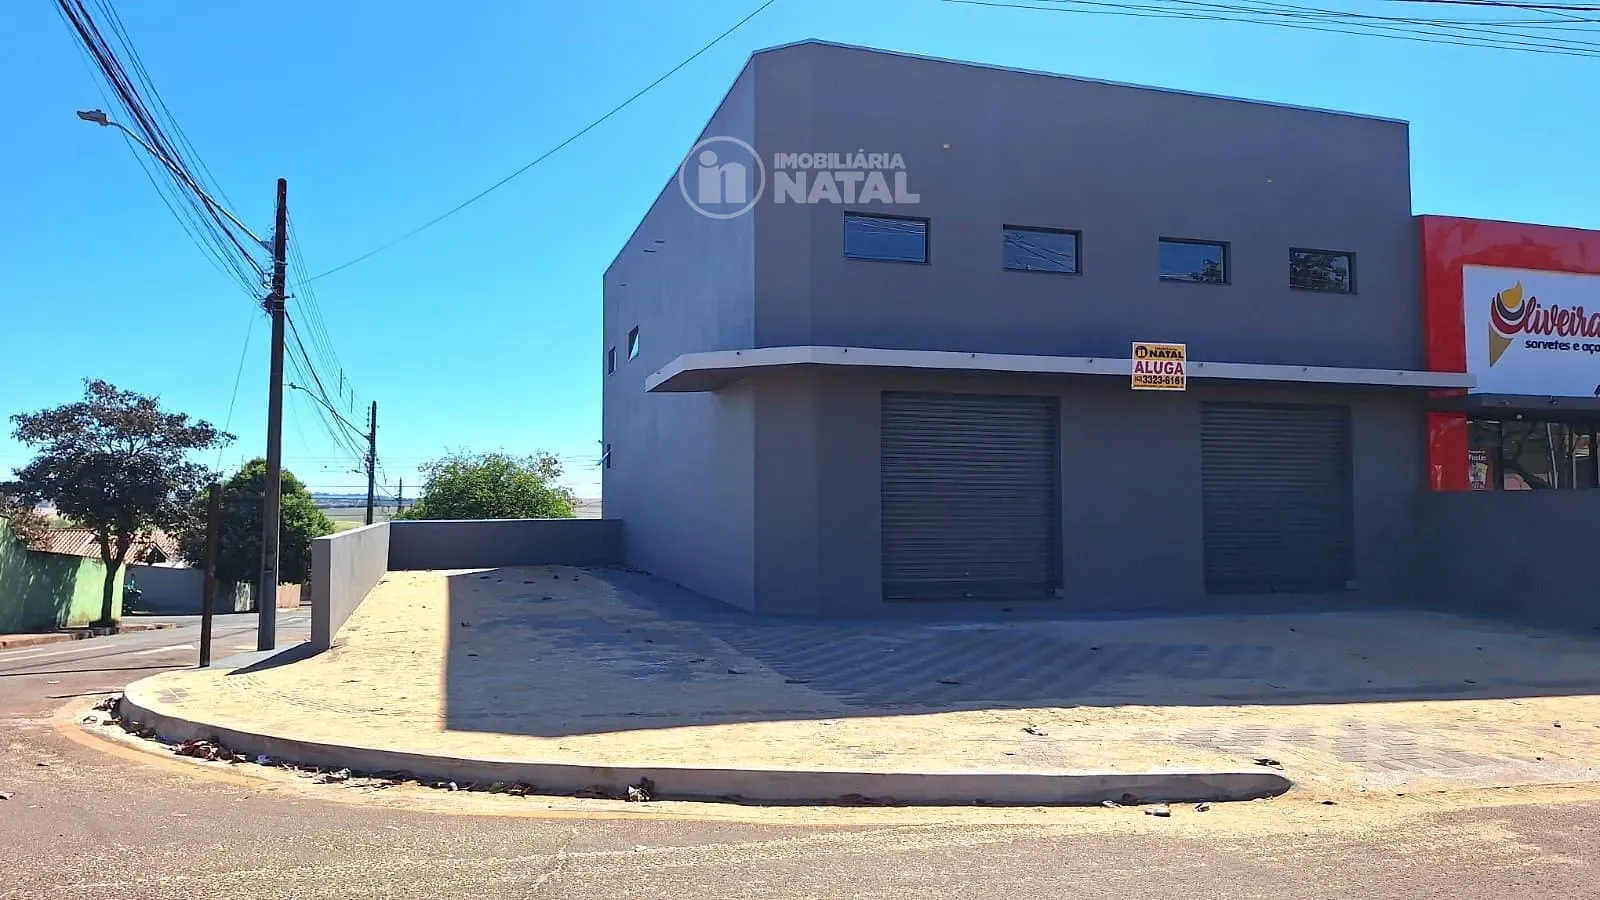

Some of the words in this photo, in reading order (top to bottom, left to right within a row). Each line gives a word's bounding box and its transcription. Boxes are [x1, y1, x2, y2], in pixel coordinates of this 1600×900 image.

[1525, 340, 1570, 351] sorvetes
[1573, 342, 1580, 351] e
[1149, 350, 1184, 358] NATAL
[1134, 360, 1184, 375] ALUGA
[1143, 375, 1184, 385] 3323-6161
